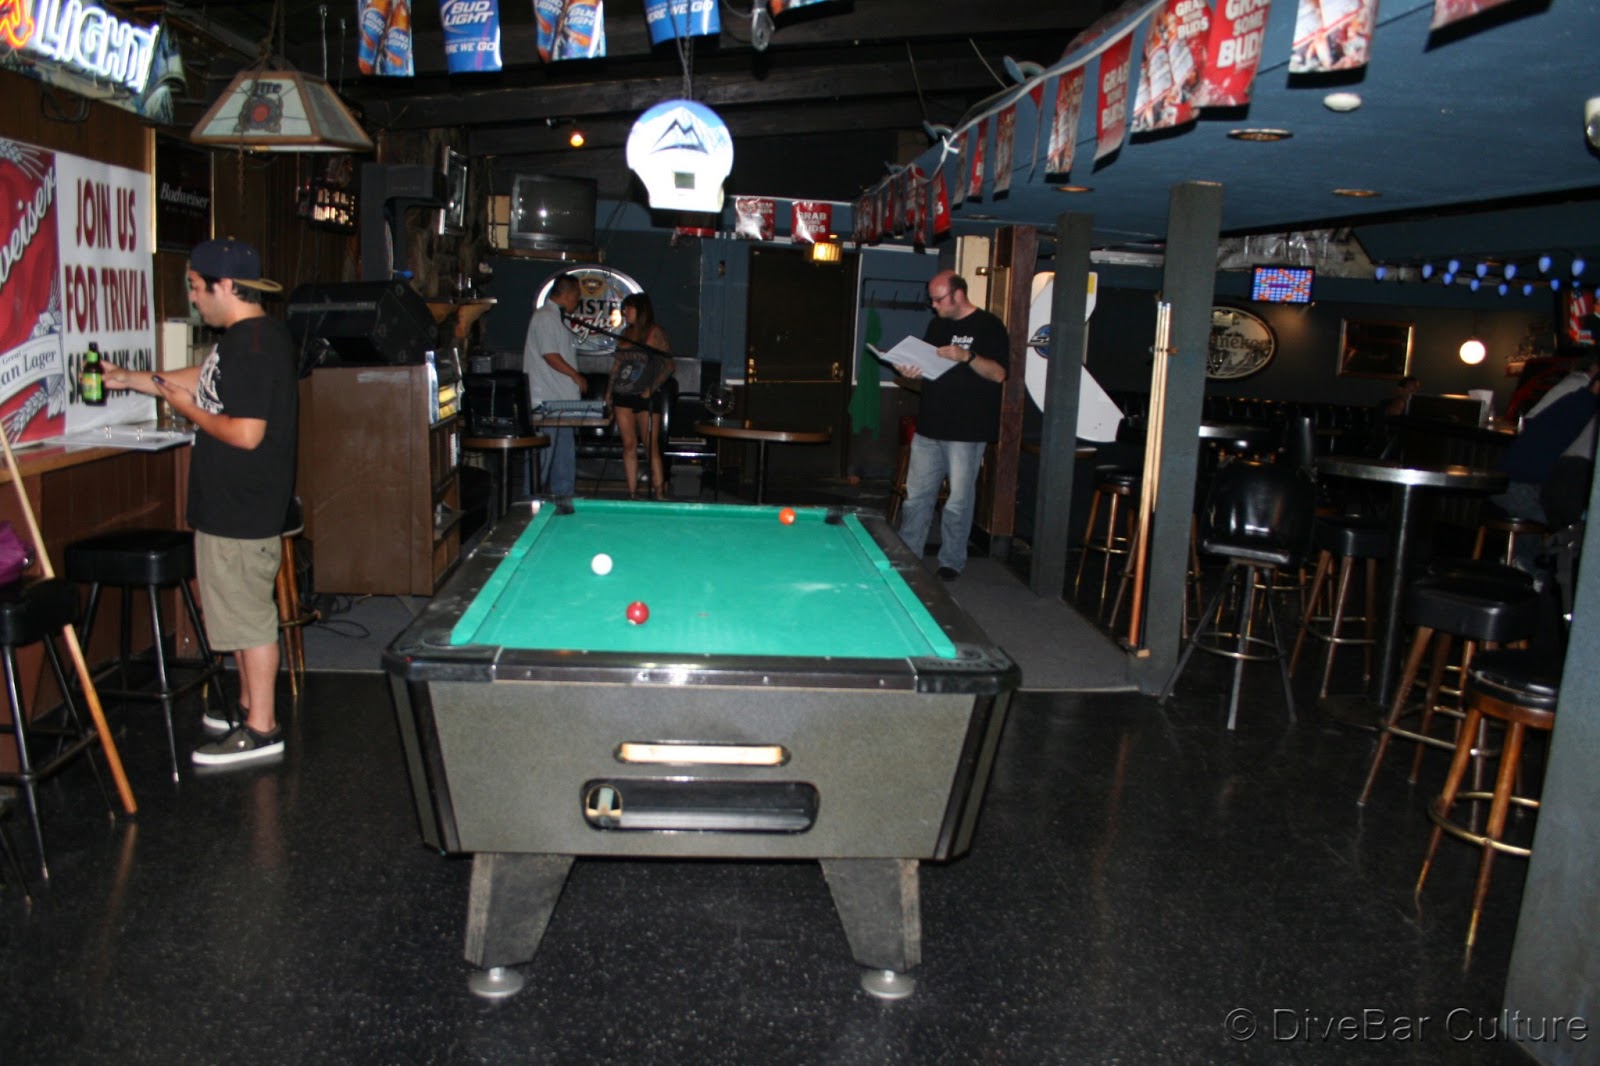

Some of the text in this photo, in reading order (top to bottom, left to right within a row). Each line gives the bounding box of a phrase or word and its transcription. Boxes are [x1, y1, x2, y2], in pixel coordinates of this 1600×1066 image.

[451, 0, 491, 14] BUD
[690, 0, 714, 13] GO
[445, 11, 495, 26] LIGHT
[1177, 16, 1209, 39] BUDS
[35, 0, 160, 93] LIGHT
[477, 41, 497, 51] GO
[160, 182, 209, 209] Budweiser
[76, 177, 137, 252] JOIN US
[65, 264, 150, 333] FOR TRIVIA
[24, 351, 56, 372] Lager
